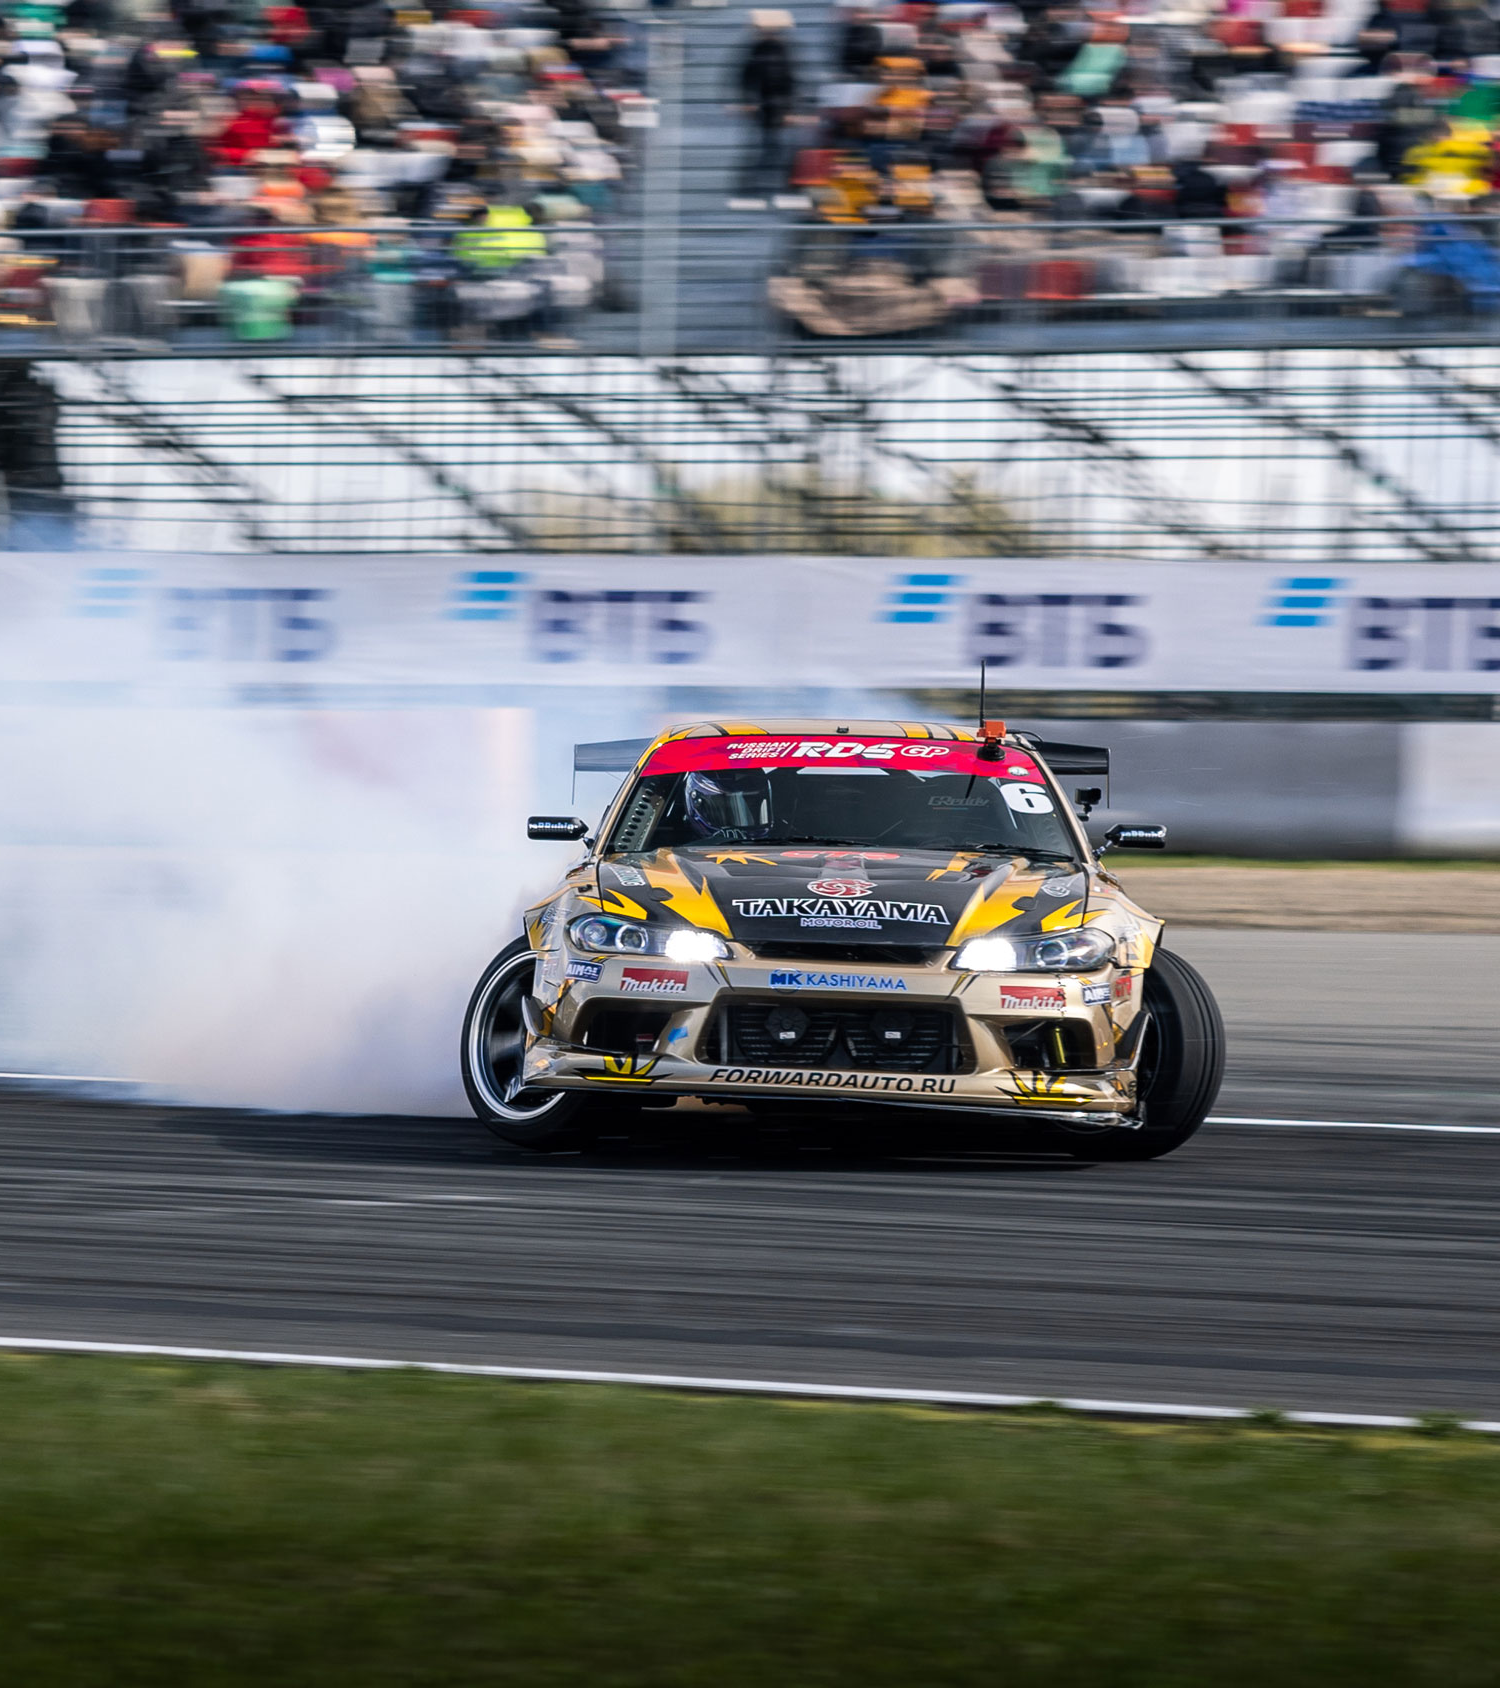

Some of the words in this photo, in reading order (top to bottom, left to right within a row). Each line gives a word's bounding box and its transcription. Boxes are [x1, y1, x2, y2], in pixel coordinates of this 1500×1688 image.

[528, 590, 712, 665] ВТБ
[964, 594, 1150, 668] ВТБ
[726, 742, 791, 750] RUSSIAN
[792, 742, 903, 759] RDS
[901, 745, 949, 758] GP
[1000, 782, 1054, 814] 6
[732, 898, 951, 925] TAKAYAMA
[801, 918, 855, 928] MOTOR
[855, 919, 882, 930] OIL
[770, 972, 801, 986] MK
[805, 973, 908, 991] KASHIYAMA
[709, 1068, 956, 1094] FORWARDAUTO.RU
